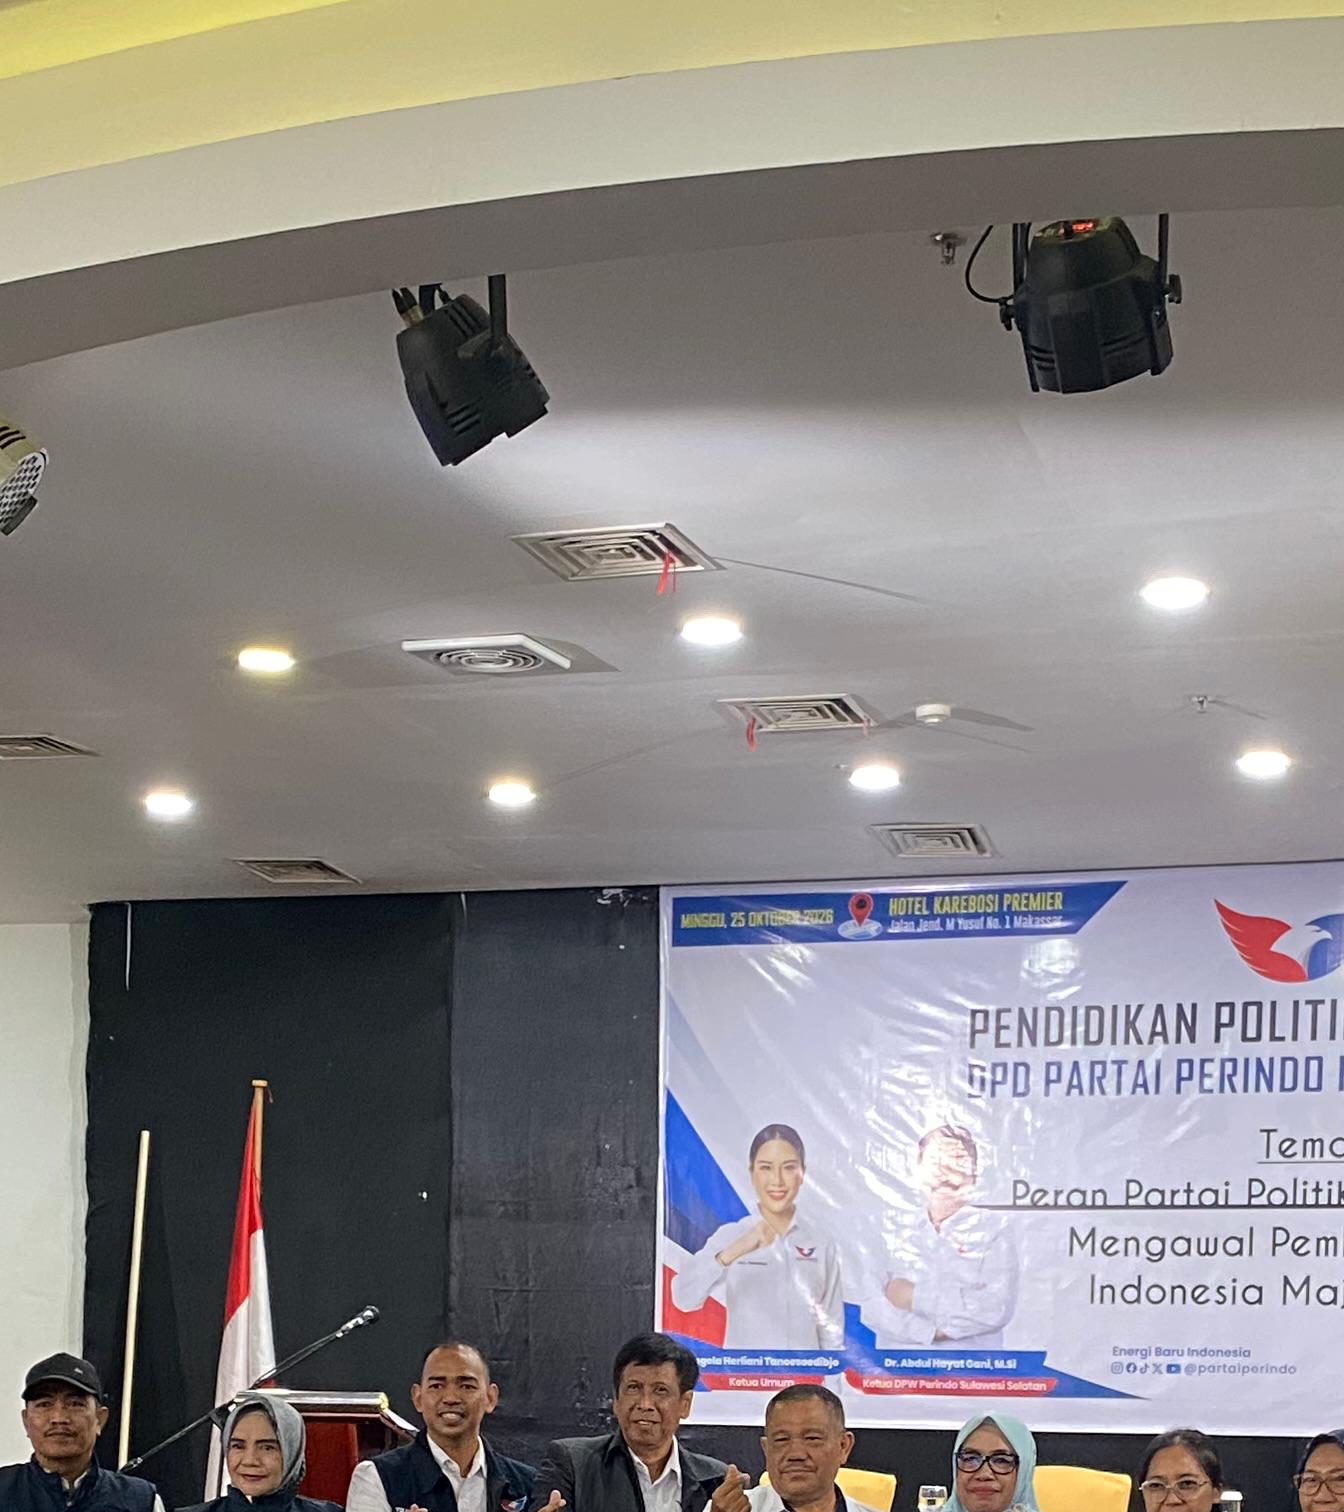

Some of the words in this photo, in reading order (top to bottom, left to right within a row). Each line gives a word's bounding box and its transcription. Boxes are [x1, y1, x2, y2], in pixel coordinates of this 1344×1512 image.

[889, 896, 930, 916] HOTEL
[933, 894, 999, 914] KAREBOSI
[1003, 891, 1064, 912] PREMIER
[731, 911, 745, 927] 25
[802, 908, 834, 925] 2026
[891, 919, 915, 933] Jalan
[918, 918, 943, 932] Jend.
[946, 918, 955, 929] M
[957, 916, 984, 930] Yusuf
[1013, 914, 1064, 928] Makassar
[968, 1002, 1197, 1050] PENDIDIKAN
[1044, 1057, 1164, 1098] PARTAI
[1175, 1055, 1324, 1094] PERINDO
[1012, 1179, 1108, 1207] Peran
[1124, 1179, 1236, 1207] Partai
[1068, 1225, 1253, 1267] Mengawal
[1089, 1273, 1264, 1307] Indonesia
[694, 1356, 721, 1367] ngela
[723, 1356, 763, 1366] Herliani
[1112, 1346, 1152, 1359] Energi
[1155, 1347, 1185, 1357] Baru
[1187, 1347, 1252, 1358] Indonesia
[884, 1358, 899, 1368] Dr.
[900, 1359, 931, 1368] Abdul
[932, 1359, 966, 1371] Hayat
[967, 1360, 993, 1370] Gani,
[994, 1360, 1016, 1369] M.Si
[1184, 1363, 1297, 1376] @partaiperindo
[728, 1378, 758, 1387] Ketua
[760, 1378, 795, 1387] Umum
[862, 1379, 892, 1389] Ketua
[894, 1380, 918, 1389] DPW
[919, 1380, 957, 1390] Perindo
[959, 1381, 1005, 1390] Sulawesi
[1006, 1381, 1047, 1391] Selatan
